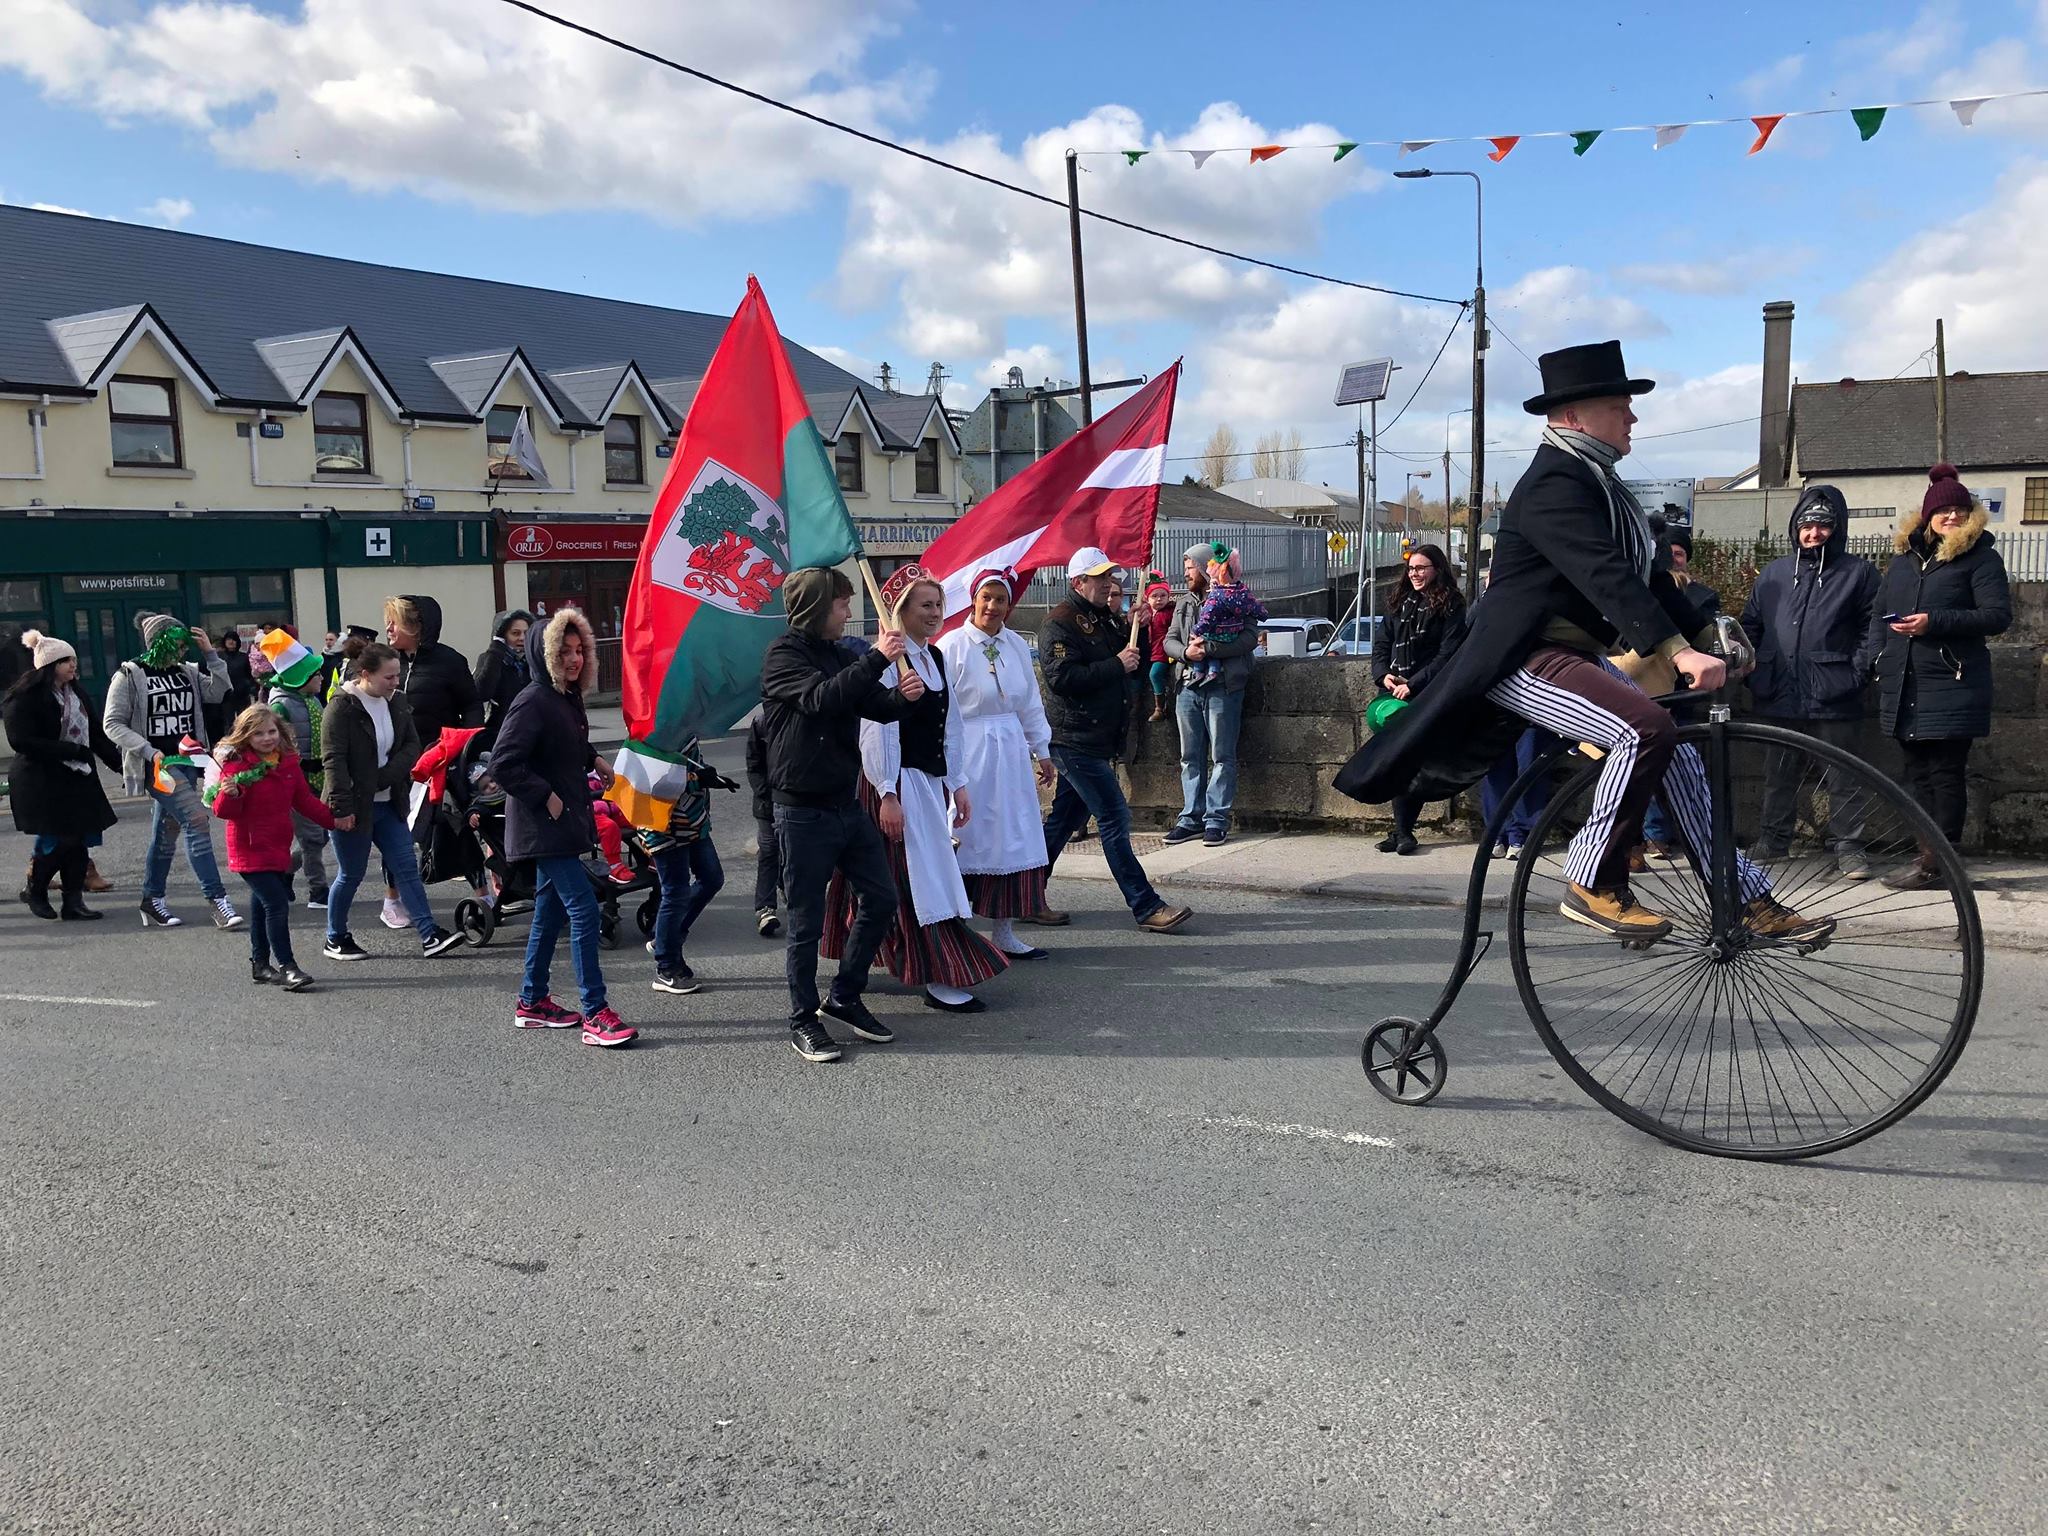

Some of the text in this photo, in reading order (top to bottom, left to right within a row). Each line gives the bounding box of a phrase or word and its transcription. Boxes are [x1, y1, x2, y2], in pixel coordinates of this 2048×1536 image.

[264, 423, 282, 431] TOTAL
[515, 542, 544, 553] ORLIK
[555, 541, 602, 550] GROCERIES
[613, 541, 637, 550] FRESH
[80, 576, 165, 591] www.petsfirst.ie
[147, 673, 191, 692] WILD
[153, 691, 193, 714] AND
[149, 714, 193, 736] FREE
